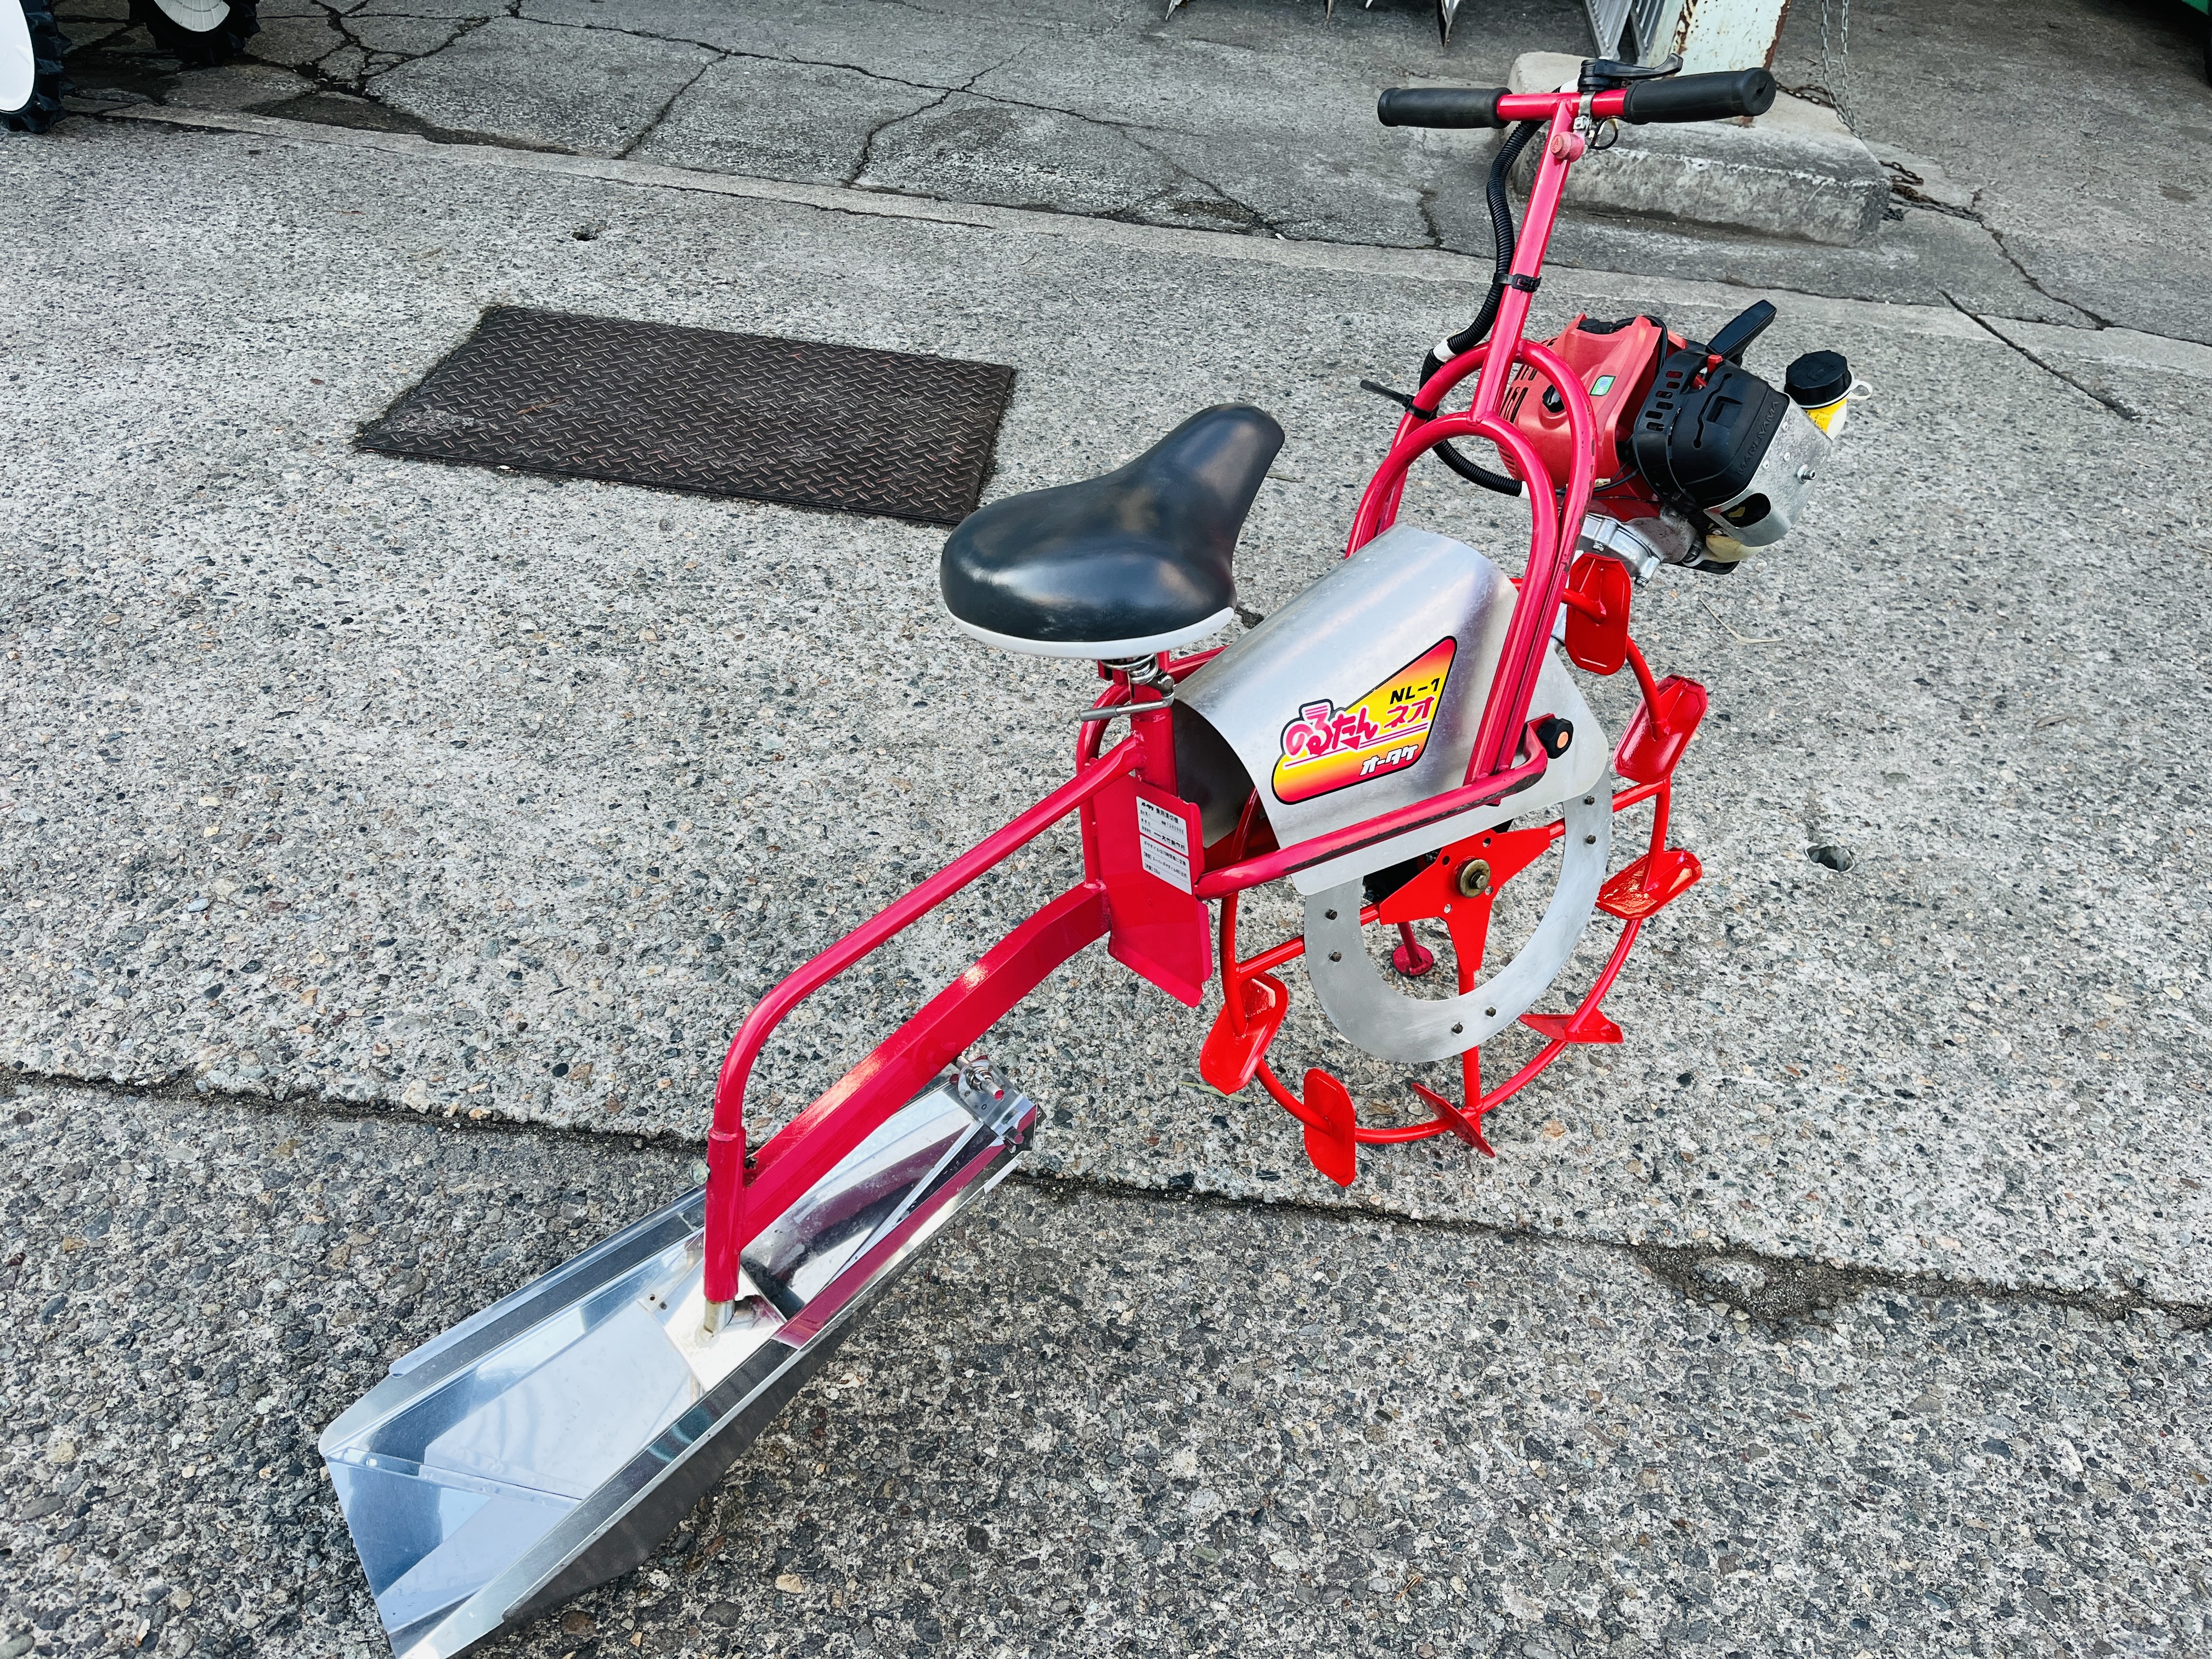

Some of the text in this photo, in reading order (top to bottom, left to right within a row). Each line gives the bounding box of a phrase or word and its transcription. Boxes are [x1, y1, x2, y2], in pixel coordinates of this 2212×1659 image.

[1737, 401, 1779, 475] MARUYAMA
[1389, 677, 1441, 705] NL-1
[1285, 696, 1435, 757] のるたん ネオ
[1359, 744, 1419, 777] オータケ
